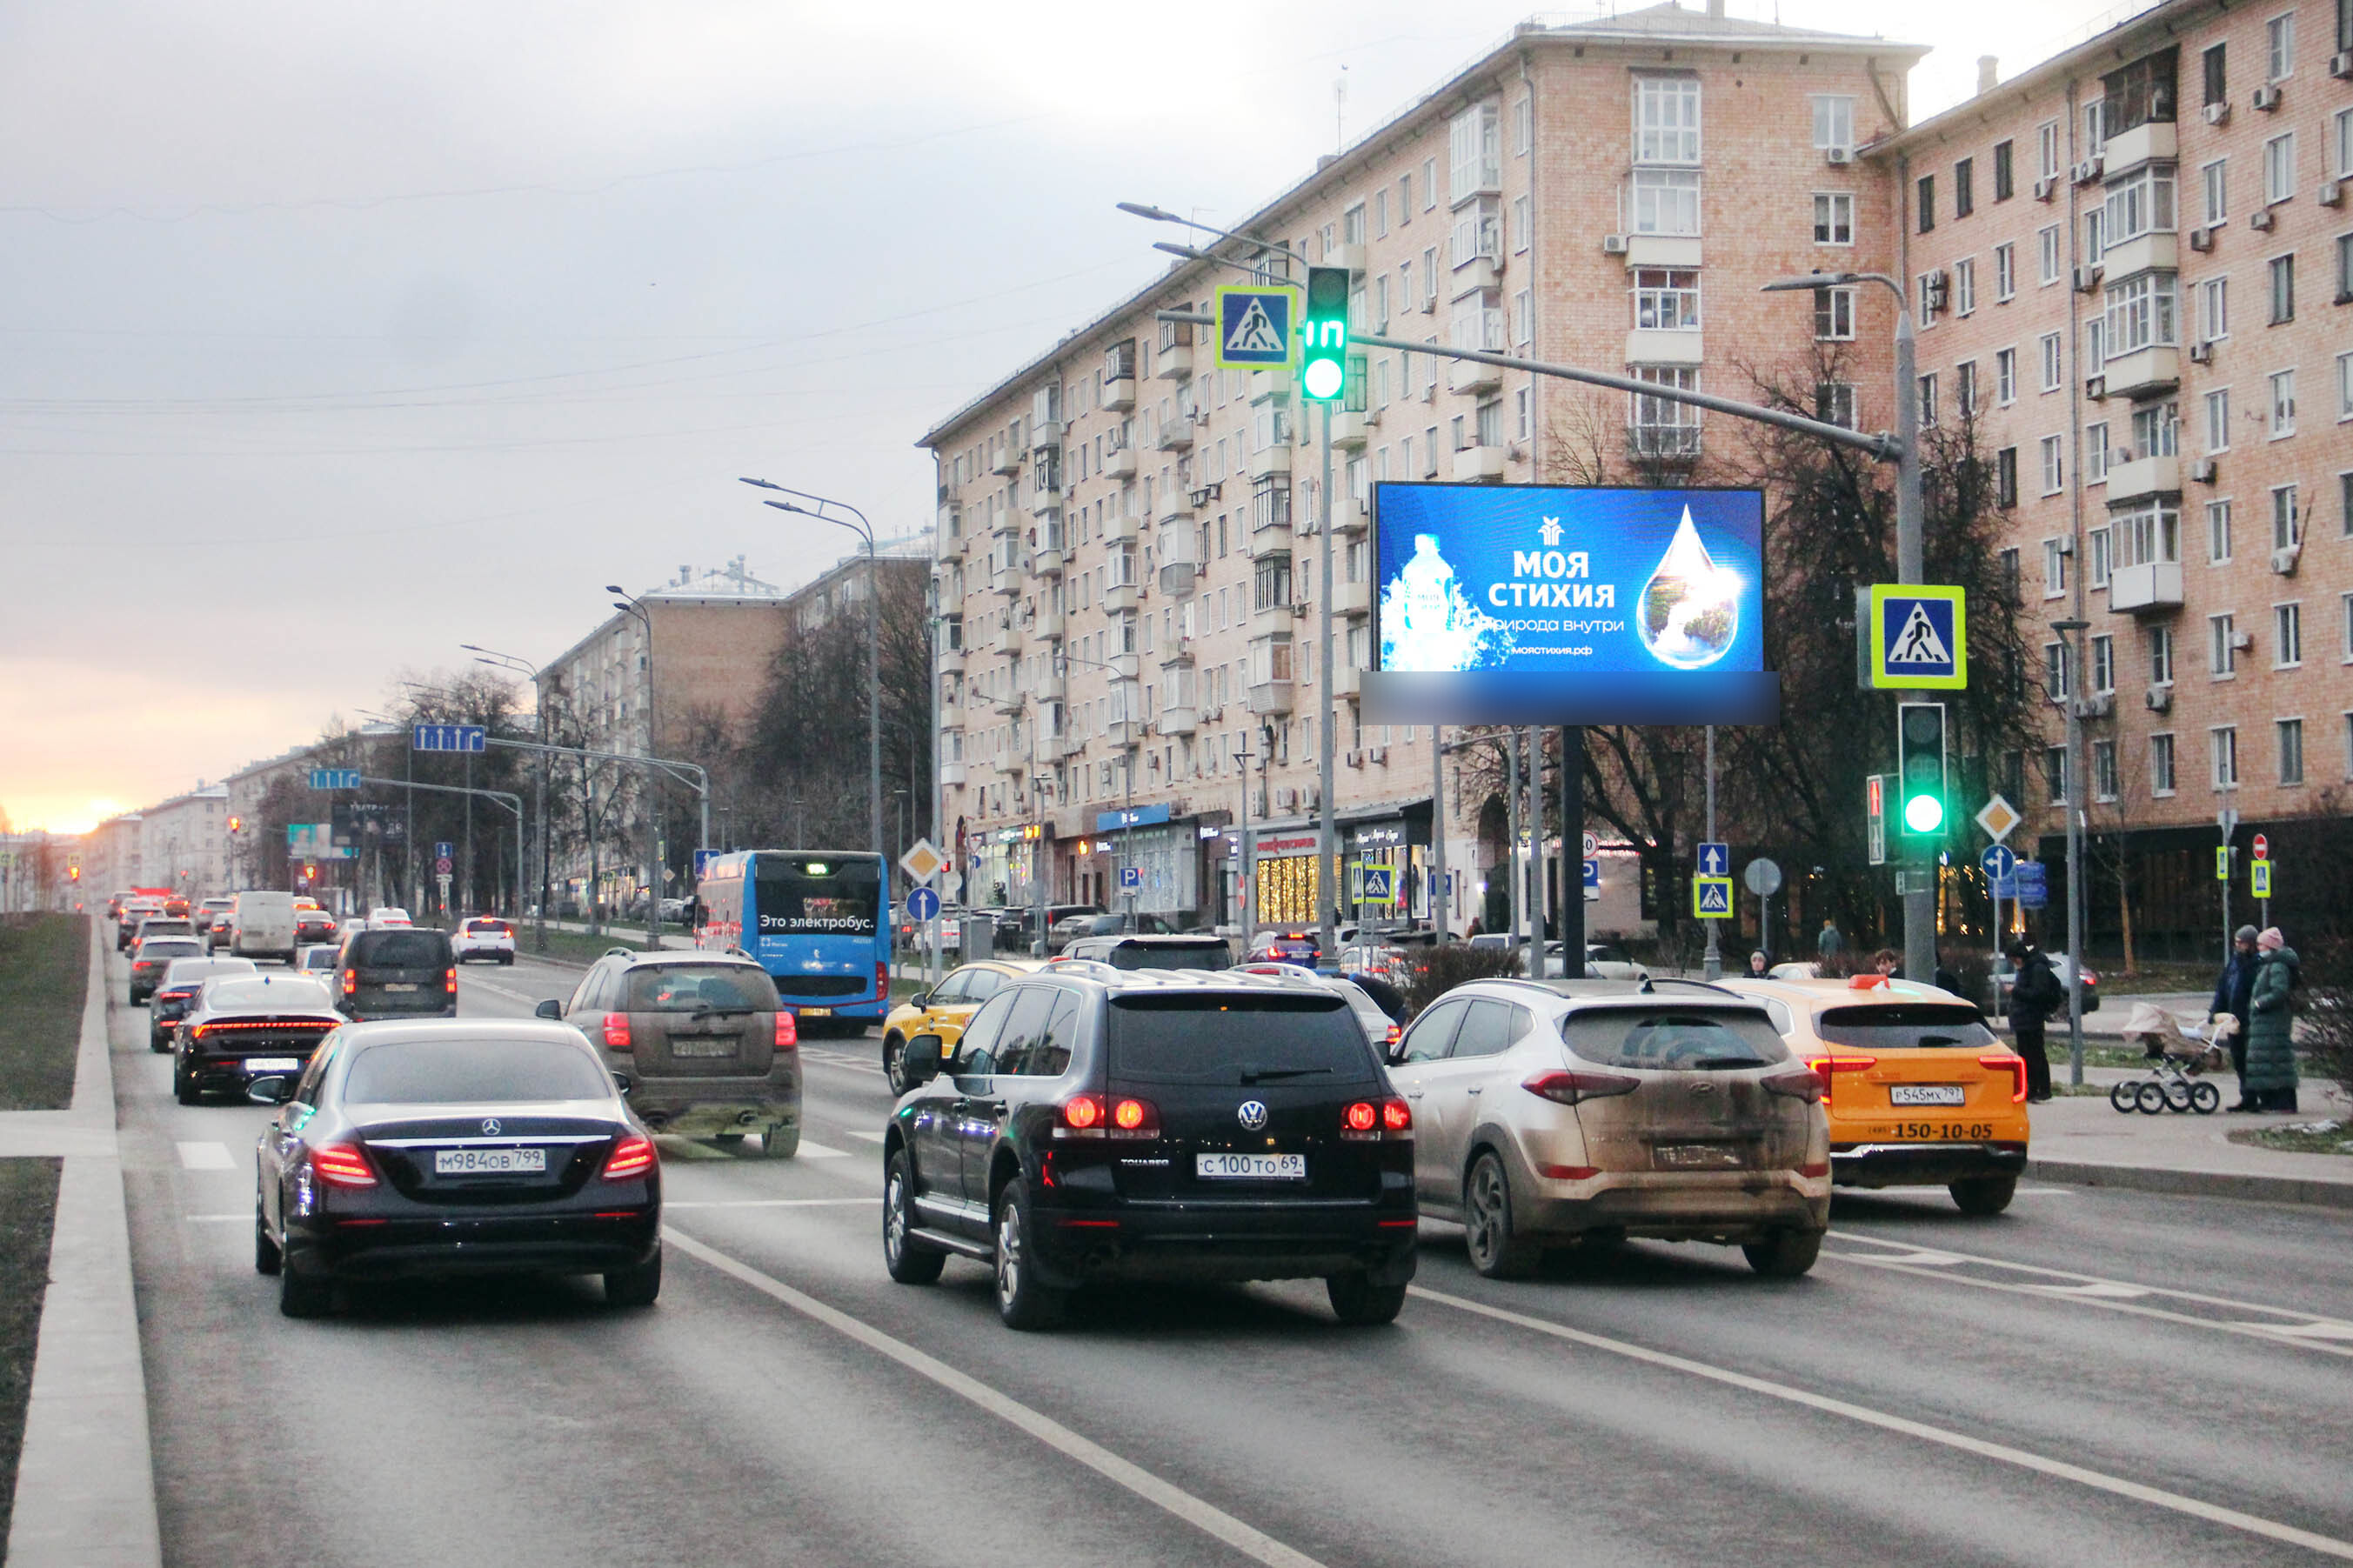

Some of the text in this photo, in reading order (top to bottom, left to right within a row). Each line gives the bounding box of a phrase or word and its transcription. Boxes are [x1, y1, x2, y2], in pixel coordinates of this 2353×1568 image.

[1514, 550, 1589, 578] МОЯ
[1488, 583, 1615, 608] СТИХИЯ
[1563, 619, 1625, 634] внутри
[1512, 645, 1593, 657] моястихия.рф
[759, 914, 874, 931] Это электробус.
[1895, 1123, 1993, 1138] 150-10-05
[514, 1151, 541, 1164] 799
[1280, 1156, 1298, 1170] 69
